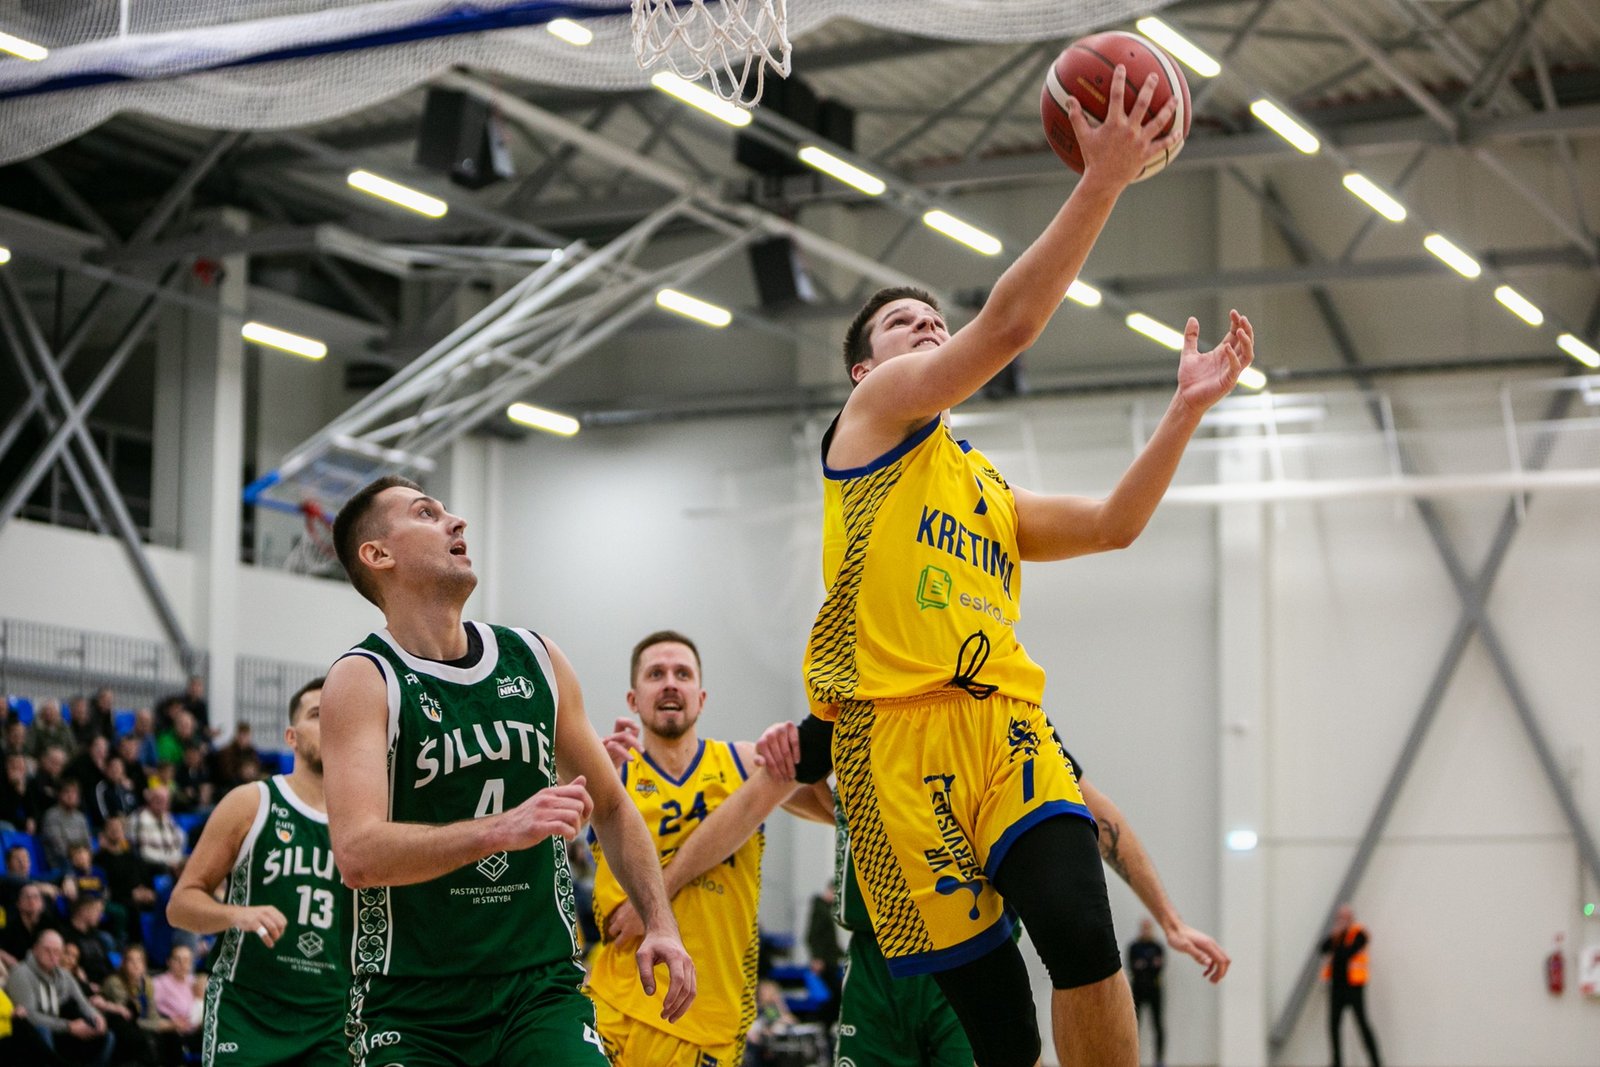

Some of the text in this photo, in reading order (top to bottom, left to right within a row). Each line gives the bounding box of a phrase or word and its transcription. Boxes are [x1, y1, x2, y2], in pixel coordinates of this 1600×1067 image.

[500, 685, 521, 696] NKL
[414, 720, 550, 789] ŠILUTĖ
[474, 778, 505, 820] 4
[658, 790, 708, 836] 24
[263, 846, 335, 886] ŠILU
[924, 845, 954, 873] VR
[296, 885, 334, 930] 13
[485, 882, 530, 894] DIAGNOSTIKA
